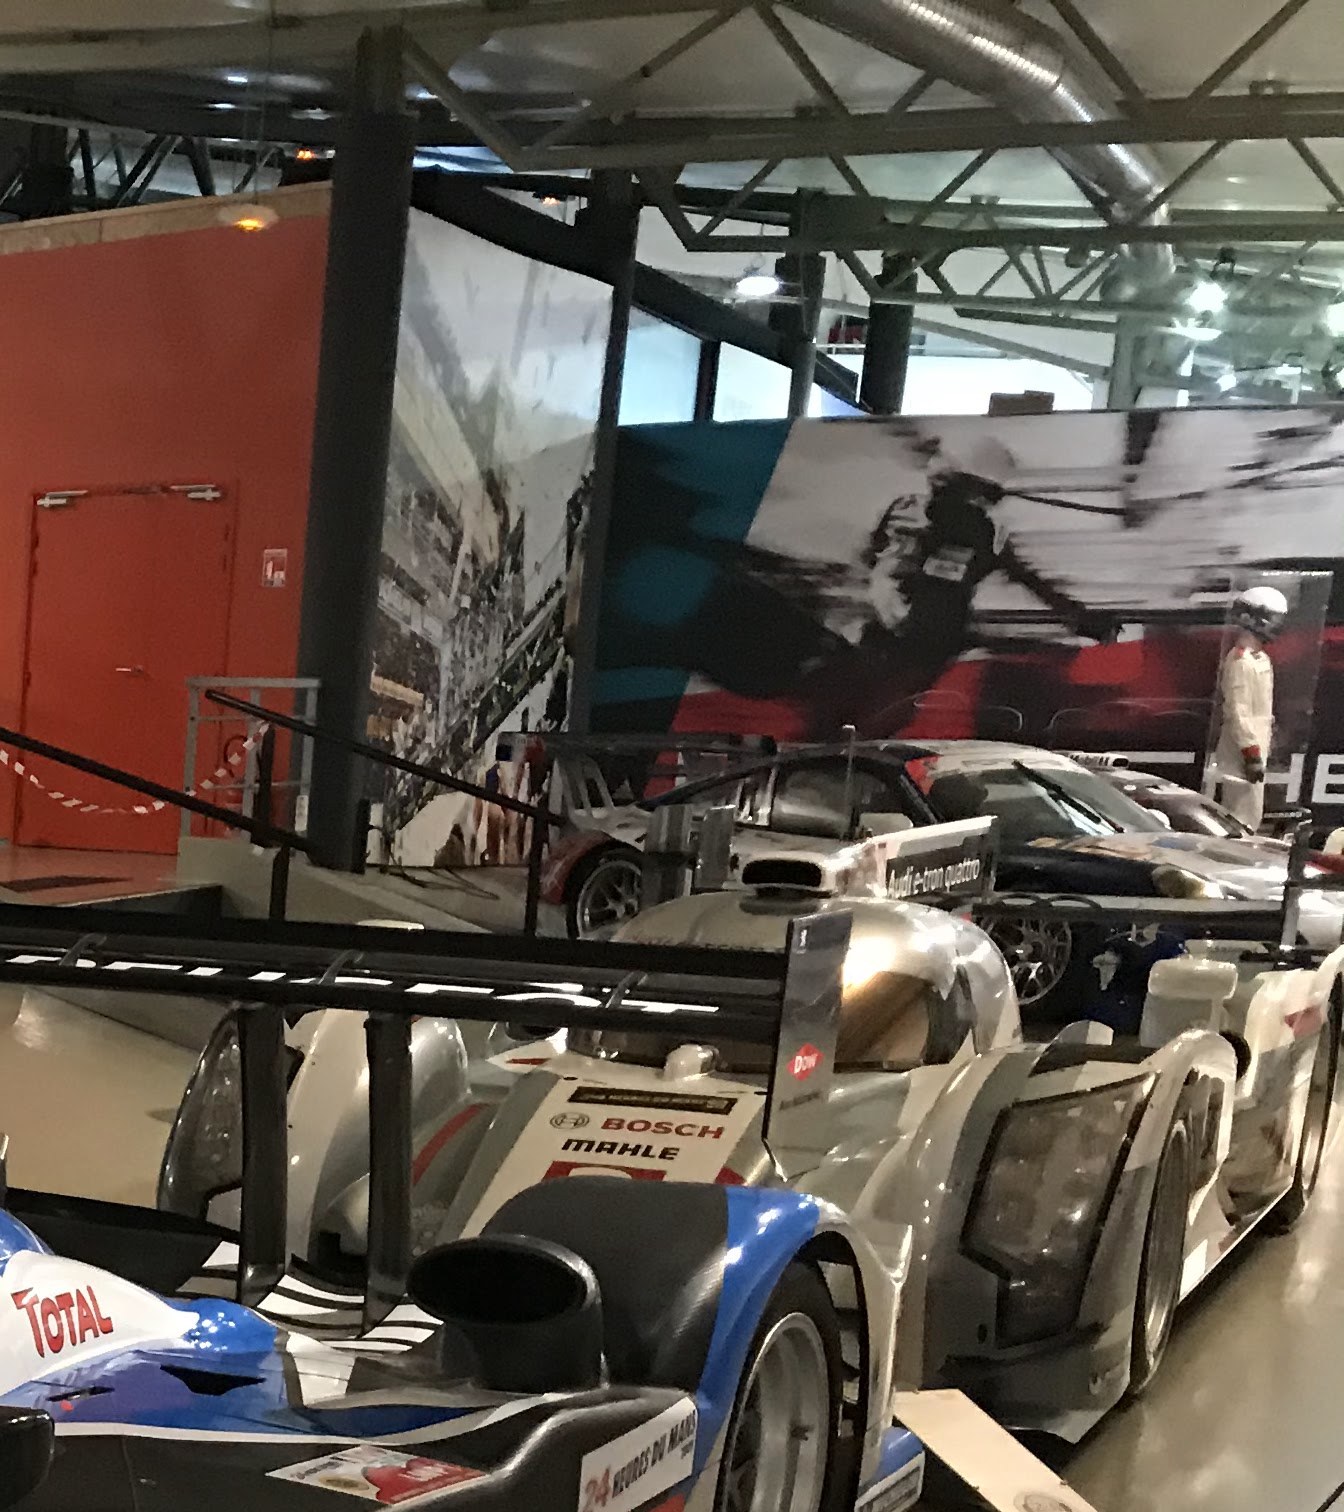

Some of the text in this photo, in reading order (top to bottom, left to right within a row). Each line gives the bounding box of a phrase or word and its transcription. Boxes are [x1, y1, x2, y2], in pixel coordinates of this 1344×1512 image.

[888, 857, 980, 899] Audi e-tron quattro
[601, 1118, 724, 1139] BOSCH
[562, 1138, 680, 1160] MAHLE
[11, 1285, 114, 1358] TOTAL
